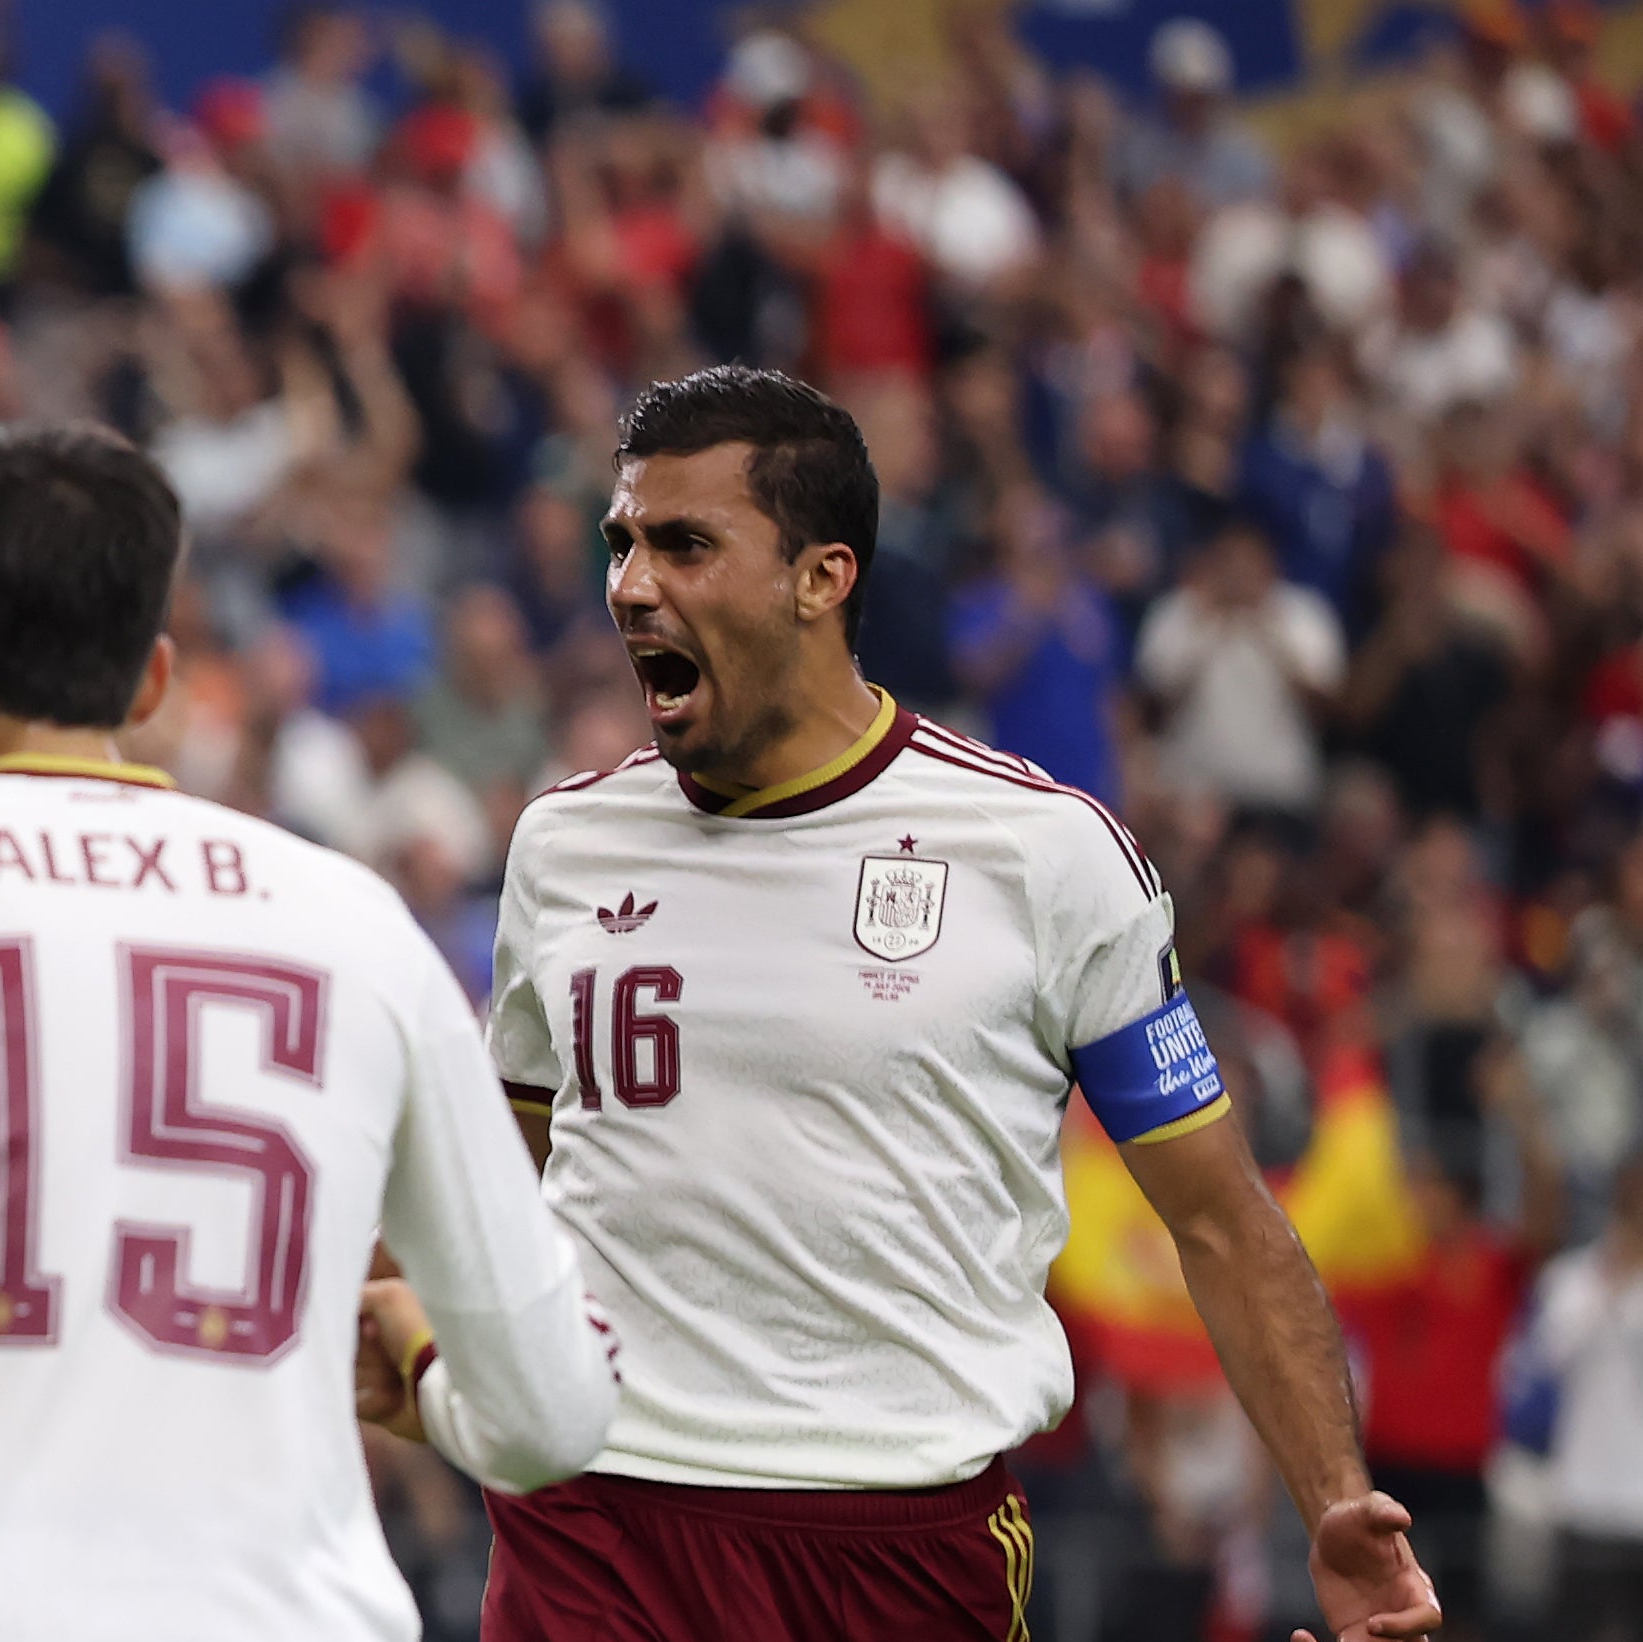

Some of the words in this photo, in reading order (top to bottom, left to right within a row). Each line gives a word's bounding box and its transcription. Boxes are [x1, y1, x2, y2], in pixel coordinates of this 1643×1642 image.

[199, 840, 272, 901] B.
[569, 964, 684, 1113] 16
[1153, 1067, 1190, 1096] the
